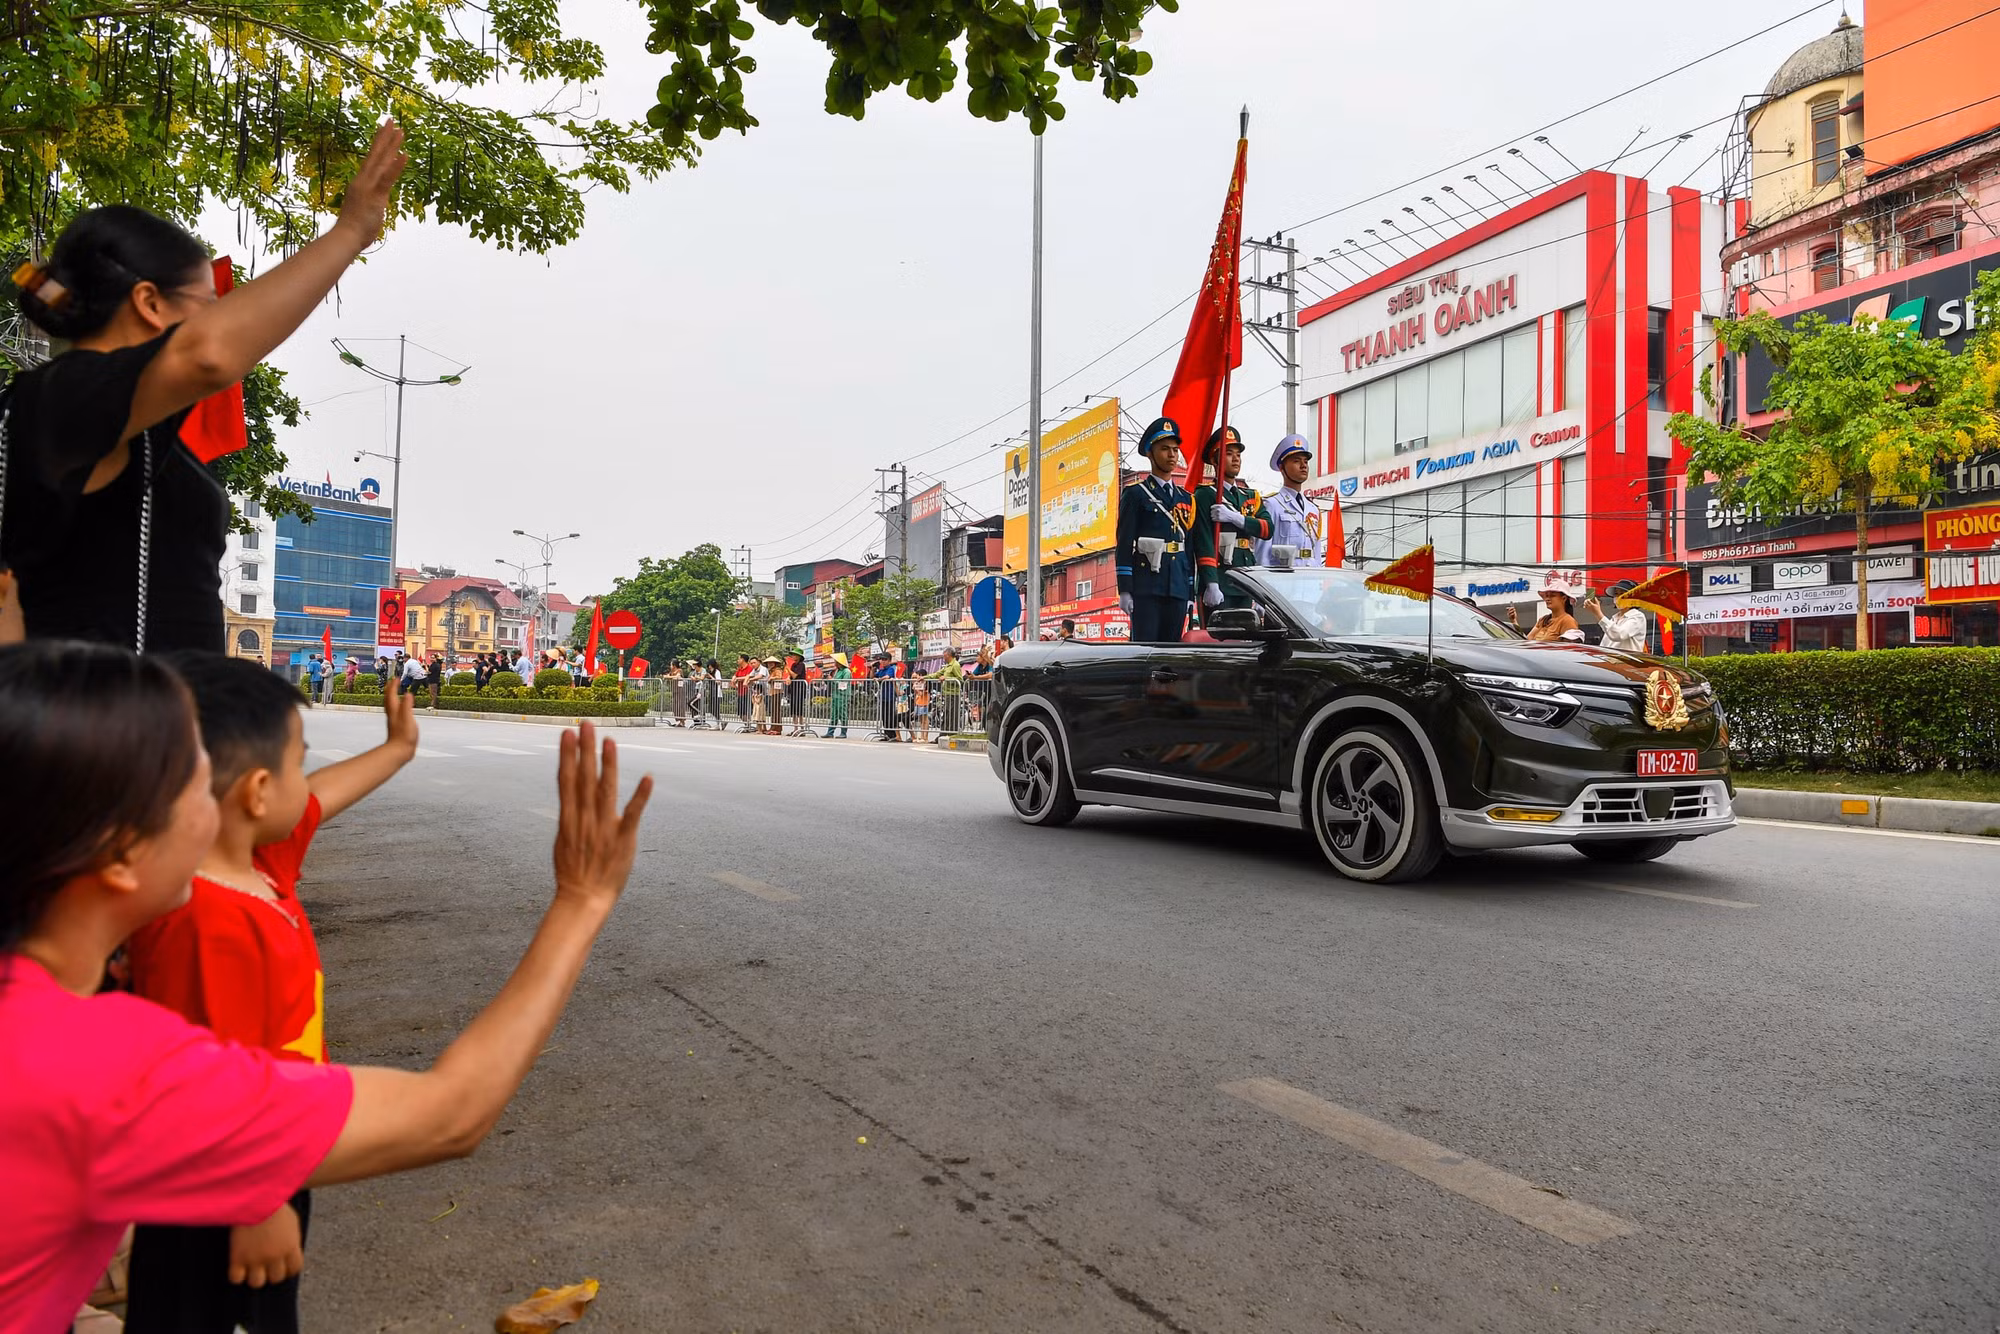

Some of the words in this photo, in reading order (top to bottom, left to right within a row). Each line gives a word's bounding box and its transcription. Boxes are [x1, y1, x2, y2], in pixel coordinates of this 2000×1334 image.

[1387, 283, 1425, 315] SIÊU
[1429, 271, 1459, 295] THỊ
[1340, 312, 1426, 373] THANH
[1434, 274, 1517, 335] OÁNH
[1529, 424, 1581, 449] Canon
[1482, 438, 1521, 461] AQUA
[1426, 450, 1476, 473] DAIKIN
[278, 475, 360, 502] VietinBank
[1009, 477, 1030, 495] Doppe
[1363, 466, 1410, 489] HITACHI
[1013, 493, 1027, 509] herz
[1936, 512, 2000, 539] PHÒNG
[1702, 549, 1718, 560] 898
[1768, 540, 1796, 553] Thanh
[1868, 556, 1906, 570] UAWEI
[1467, 578, 1531, 597] Panasonic
[1709, 572, 1740, 586] DELL
[1721, 608, 1746, 618] 2.99
[1747, 605, 1780, 618] Triệu
[1813, 602, 1836, 614] máy
[1838, 602, 1853, 611] 2G
[1887, 596, 1926, 607] 300K
[1750, 593, 1782, 604] Redmi
[1785, 591, 1800, 601] A3
[1639, 752, 1697, 773] TM-02-70
